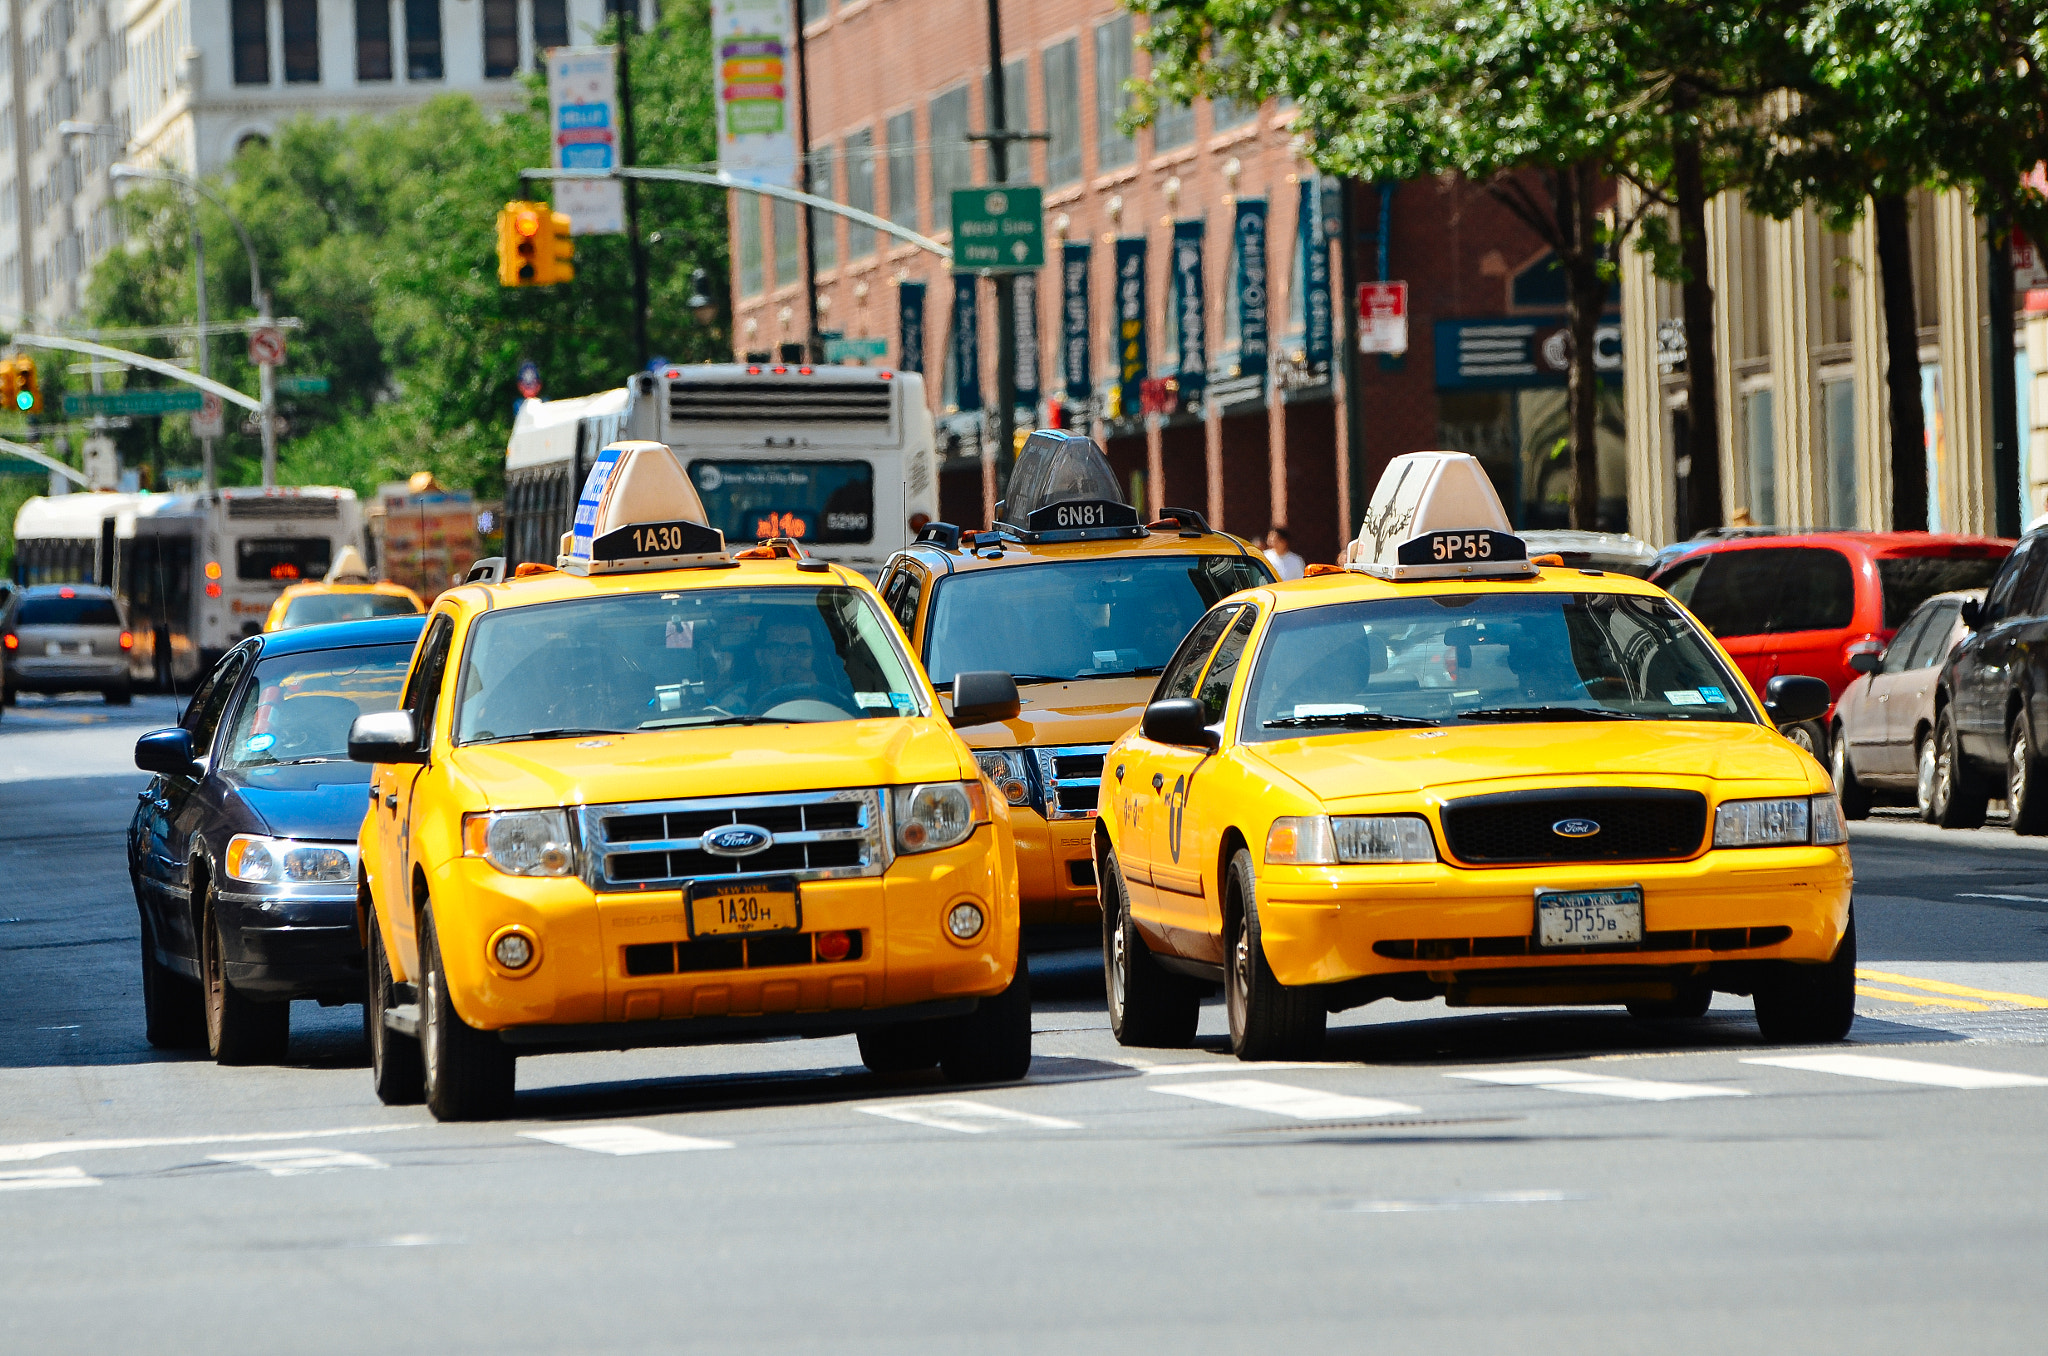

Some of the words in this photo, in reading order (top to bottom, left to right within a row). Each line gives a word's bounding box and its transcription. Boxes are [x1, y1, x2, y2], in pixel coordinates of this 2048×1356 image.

[1240, 212, 1266, 354] CHIPOTLE
[1057, 504, 1104, 526] 6N81
[632, 526, 682, 552] 1A30
[1432, 534, 1491, 560] 5P55
[1564, 821, 1589, 833] Ford
[721, 832, 754, 847] Ford
[717, 886, 741, 895] NEW
[744, 884, 769, 894] YORK
[1564, 896, 1586, 907] NEW
[1589, 894, 1616, 905] YORK
